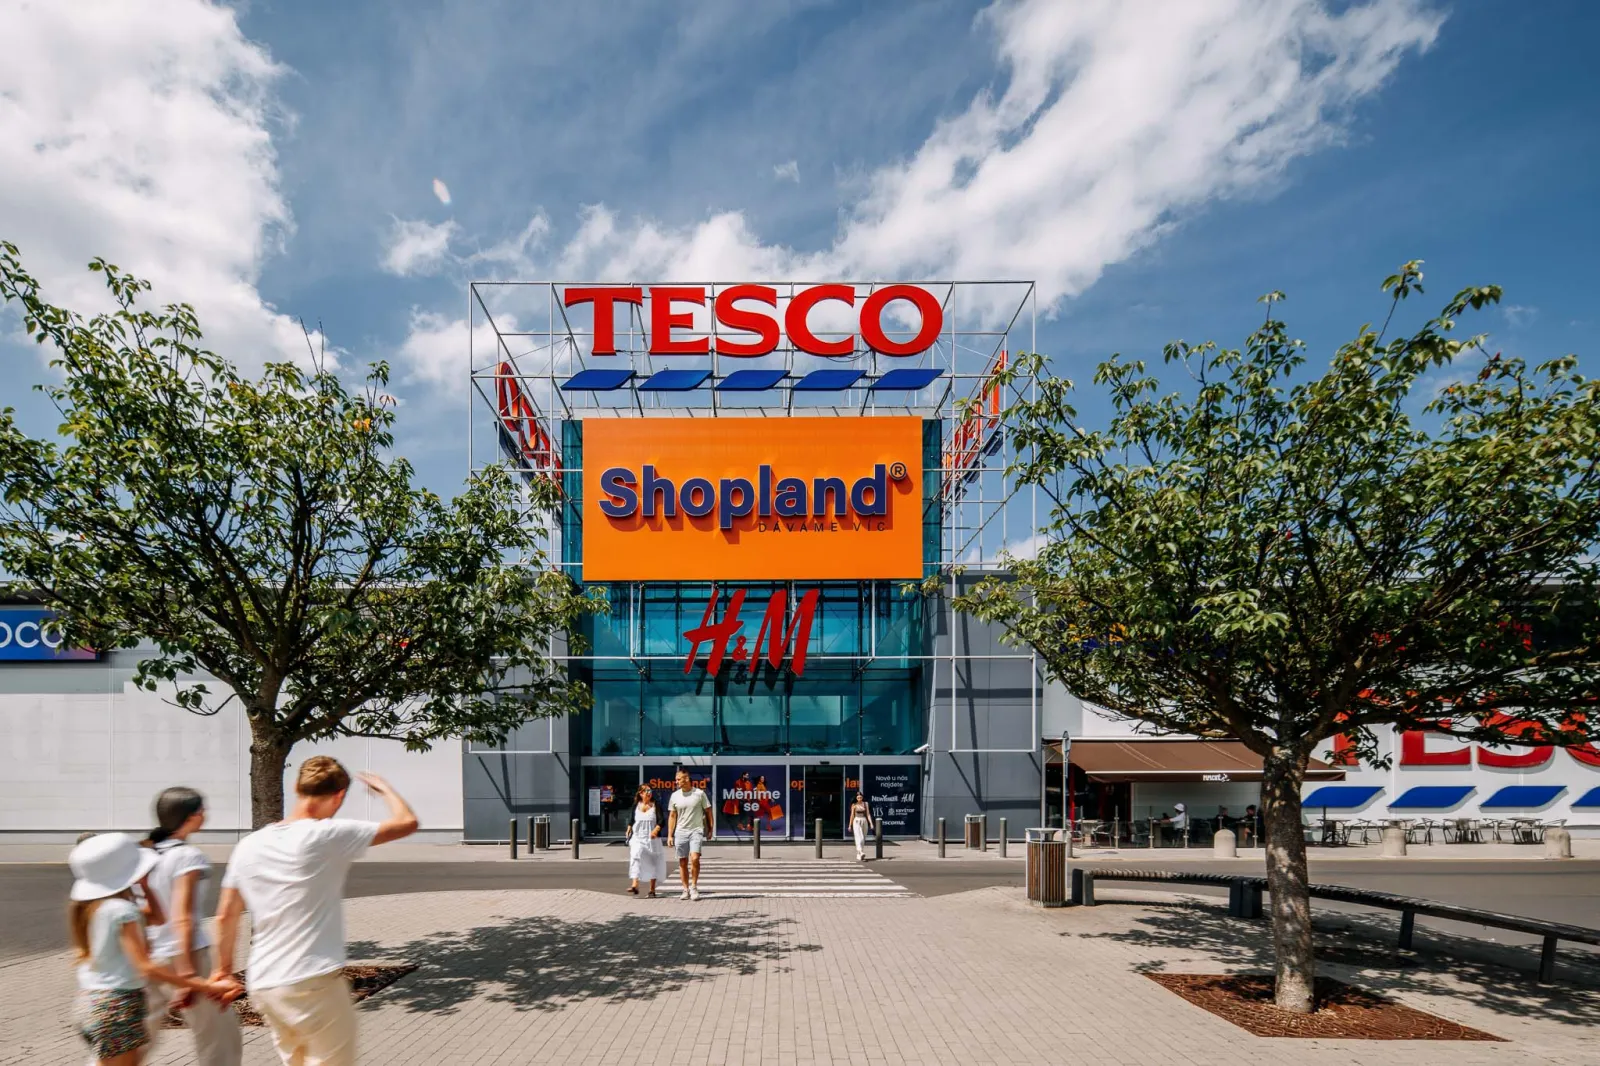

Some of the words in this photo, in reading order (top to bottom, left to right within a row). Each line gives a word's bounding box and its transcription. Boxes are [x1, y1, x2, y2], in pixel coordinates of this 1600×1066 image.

[564, 284, 943, 358] TESCO
[853, 519, 886, 532] VÍC
[683, 588, 820, 677] H&M
[722, 788, 781, 800] Měníme
[743, 802, 760, 812] se
